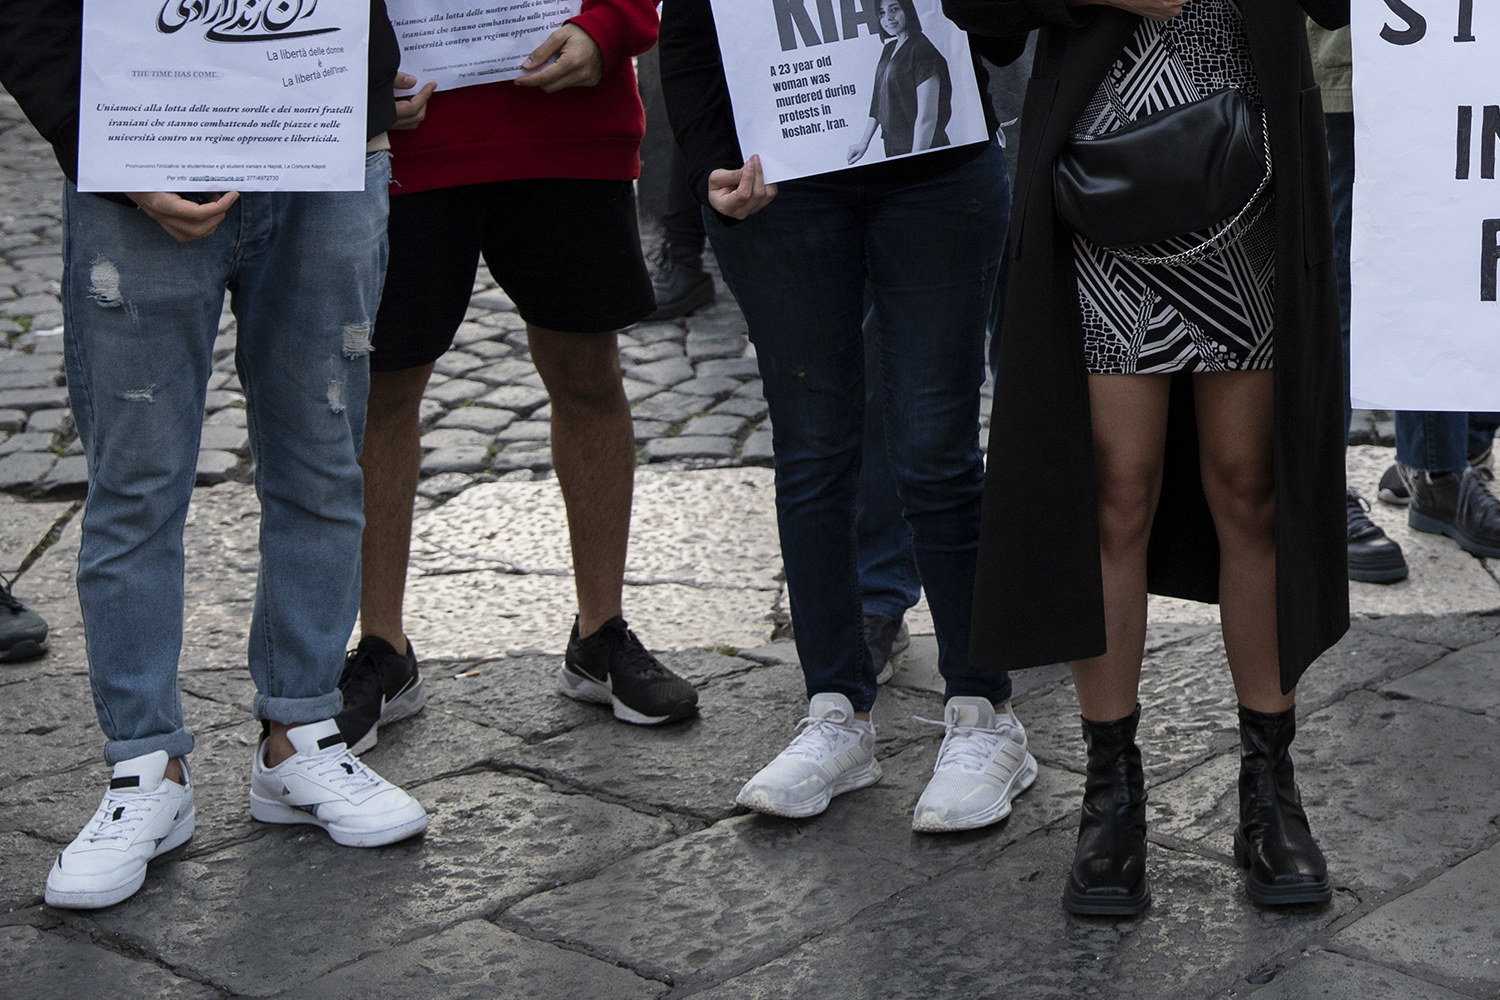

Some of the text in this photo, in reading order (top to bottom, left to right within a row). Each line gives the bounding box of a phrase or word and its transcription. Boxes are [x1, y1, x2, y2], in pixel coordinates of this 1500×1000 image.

[267, 46, 344, 61] La libertà delle donne
[771, 56, 831, 76] A 23 year old
[773, 74, 830, 92] woman was
[776, 84, 856, 107] murdered during
[779, 105, 831, 124] protests in
[782, 119, 848, 138] Noshahr, Iran.
